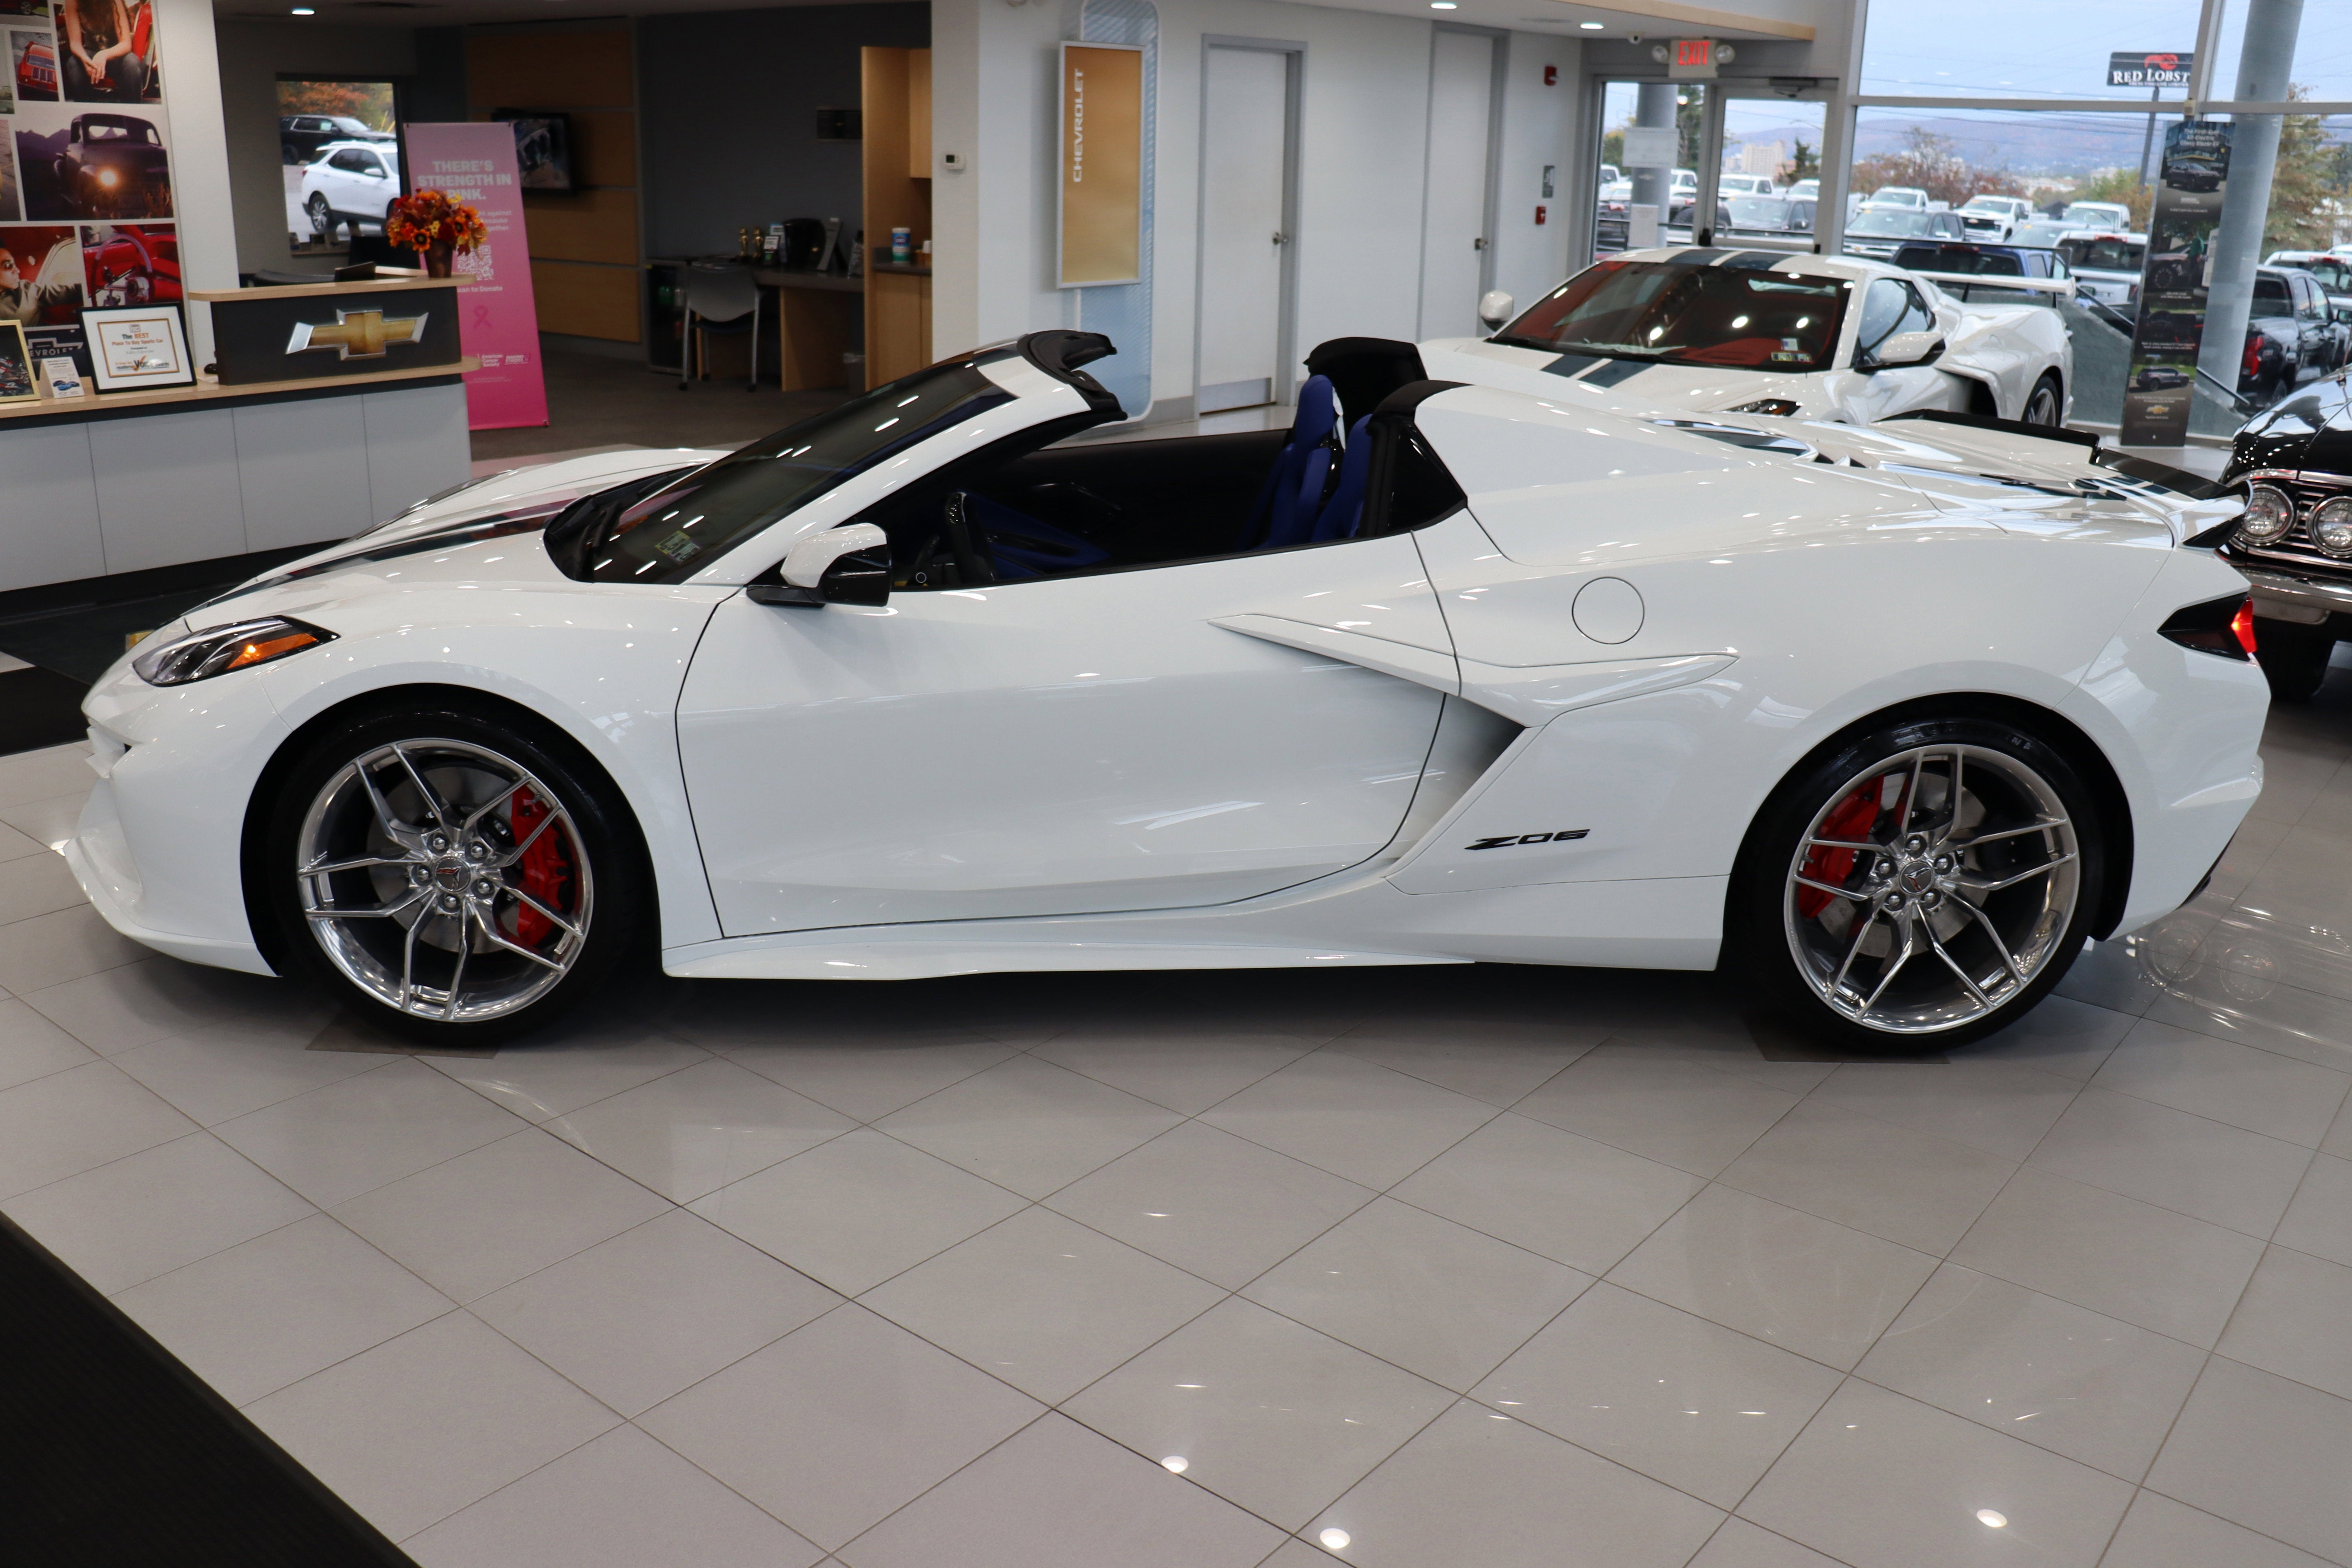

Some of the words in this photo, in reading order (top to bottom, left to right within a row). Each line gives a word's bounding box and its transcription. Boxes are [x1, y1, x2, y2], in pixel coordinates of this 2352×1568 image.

[1678, 42, 1710, 65] EXIT
[2113, 71, 2143, 84] RED
[2147, 68, 2191, 82] LOBST
[1073, 68, 1083, 182] CHEVROLET
[432, 160, 494, 172] THERE'S
[417, 174, 494, 187] STRENGTH
[496, 174, 511, 185] IN
[1464, 829, 1590, 851] Z06
